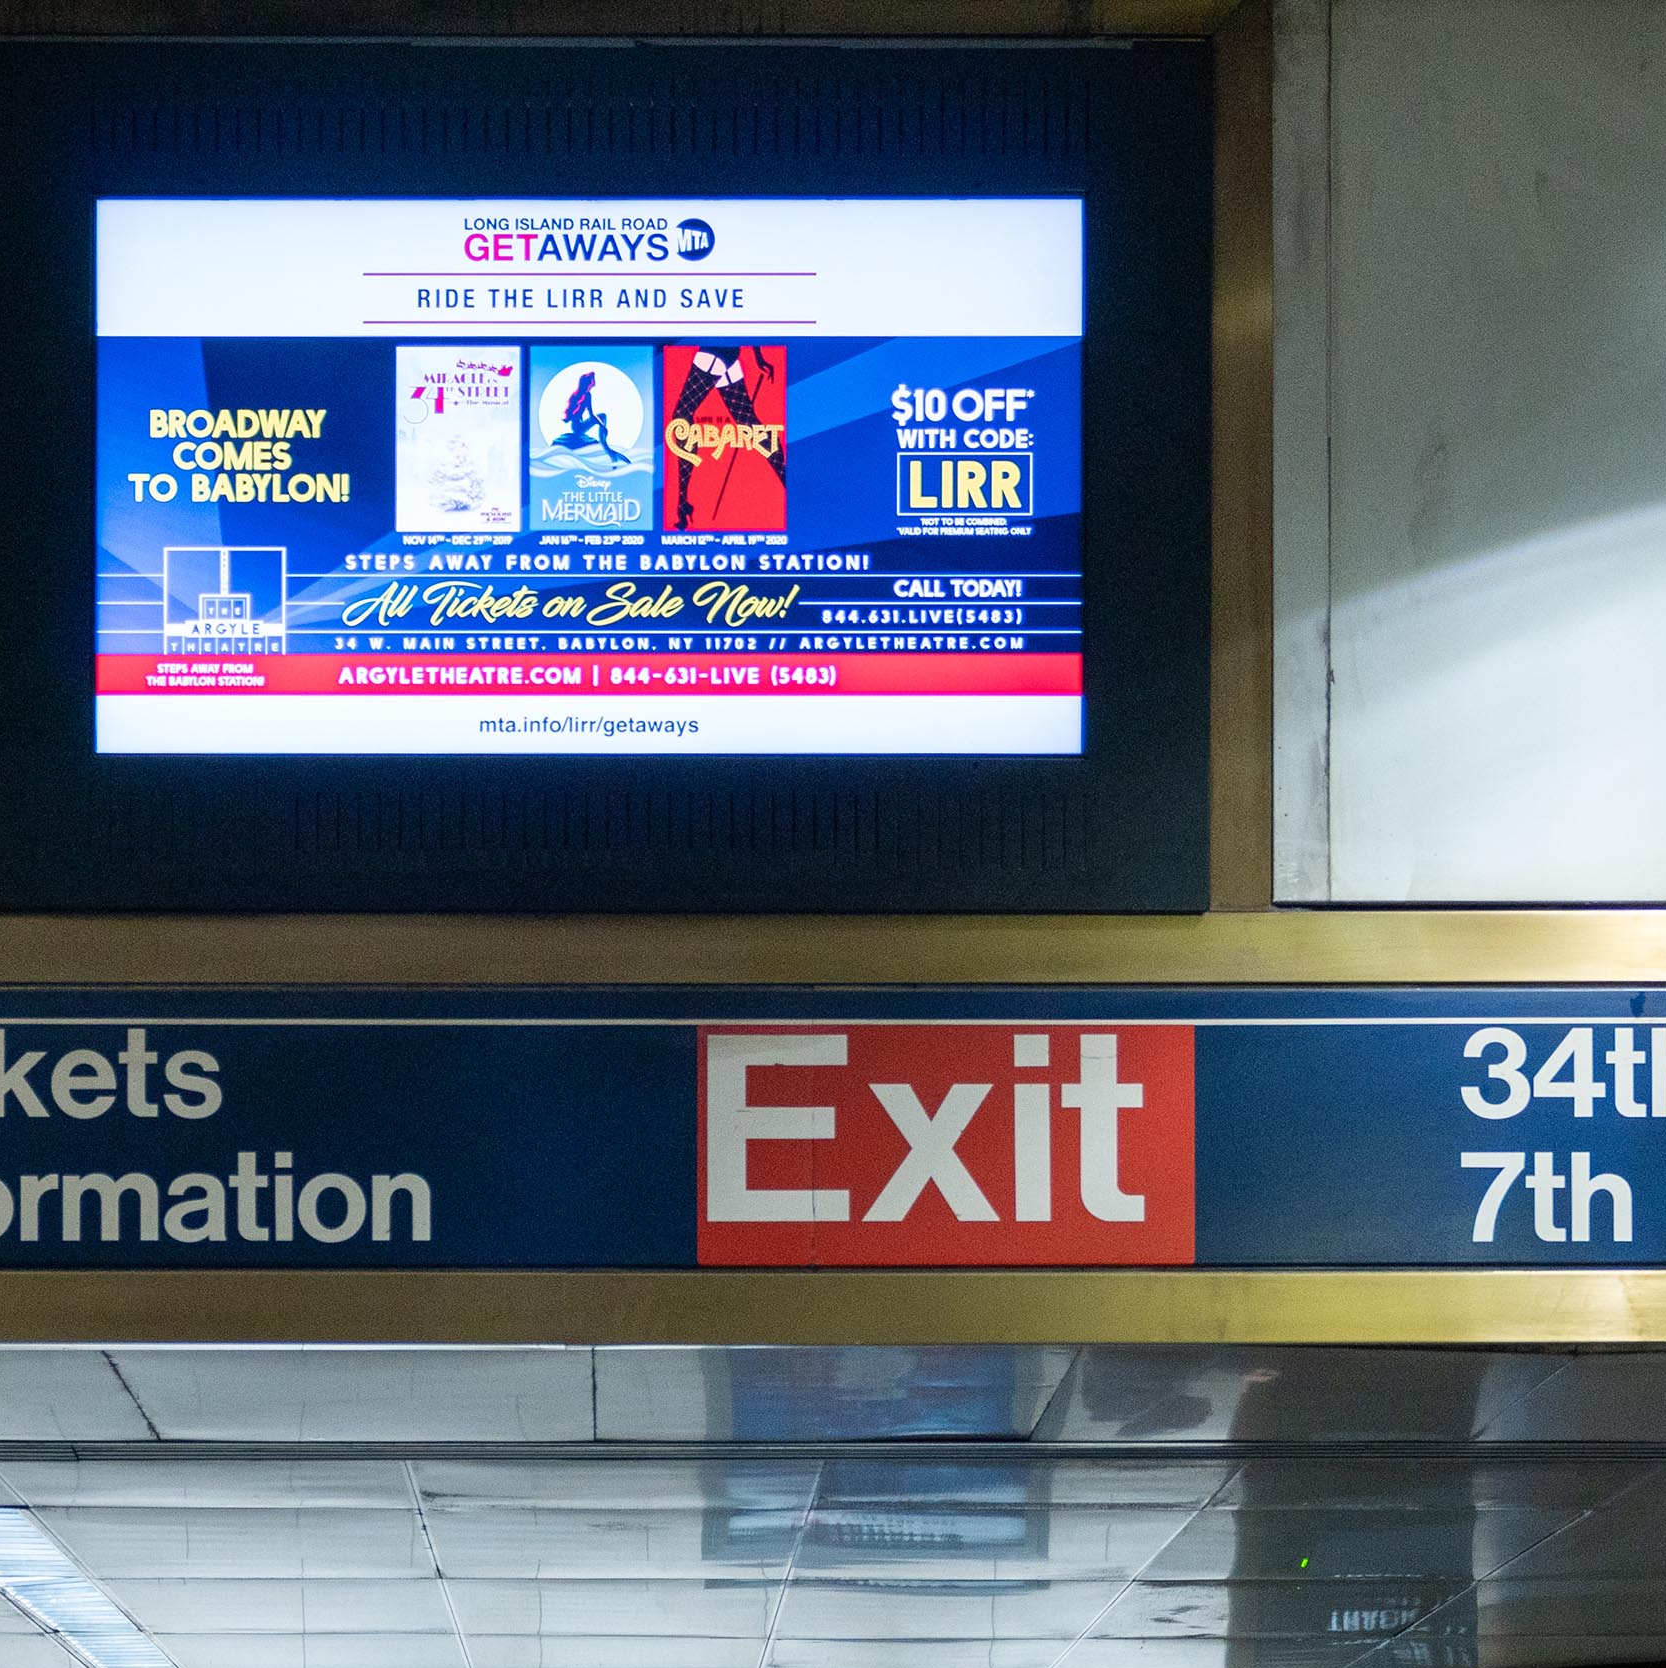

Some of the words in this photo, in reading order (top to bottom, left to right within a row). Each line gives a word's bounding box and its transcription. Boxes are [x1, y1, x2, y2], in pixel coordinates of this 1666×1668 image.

[464, 218, 510, 230] LONG
[515, 218, 574, 230] ISLAND
[580, 218, 616, 230] RAIL
[622, 218, 668, 230] ROAD
[464, 233, 669, 262] GETAWAYS
[417, 289, 475, 308] RIDE
[488, 289, 533, 308] THE
[547, 289, 603, 308] LIRR
[617, 289, 666, 308] AND
[680, 289, 744, 308] SAVE
[892, 384, 946, 426] $10
[150, 409, 326, 438] BROADWAY
[665, 418, 784, 467] CABARET
[896, 429, 956, 448] WITH
[964, 429, 1033, 448] CODE:
[173, 441, 292, 470] COMES
[128, 473, 178, 502] TO
[192, 473, 350, 502] BABYLON!
[910, 460, 1022, 508] LIRR
[542, 500, 640, 527] MERMAID
[345, 554, 416, 571] STEPS
[429, 554, 493, 571] AWAY
[506, 554, 571, 571] FROM
[583, 554, 627, 571] THE
[640, 554, 746, 571] BABYLON
[759, 554, 870, 571] STATION!
[893, 579, 945, 598] CALL
[950, 579, 1023, 598] TODAY!
[341, 581, 419, 627] All
[422, 580, 539, 627] Tickets
[542, 596, 587, 618] on
[585, 581, 685, 627] Sale
[692, 581, 800, 627] Now!
[822, 608, 1024, 625] 844.631.LIVE(5483)
[191, 623, 261, 635] ARGYLE
[338, 666, 582, 685] ARGYLETHEATRE.COM
[610, 666, 760, 685] 844-631-LIVE
[770, 665, 836, 686] (5483)
[479, 716, 699, 737] mta.info/lirr/getaways
[705, 1032, 1145, 1224] Exit
[1460, 1150, 1633, 1244] 7th
